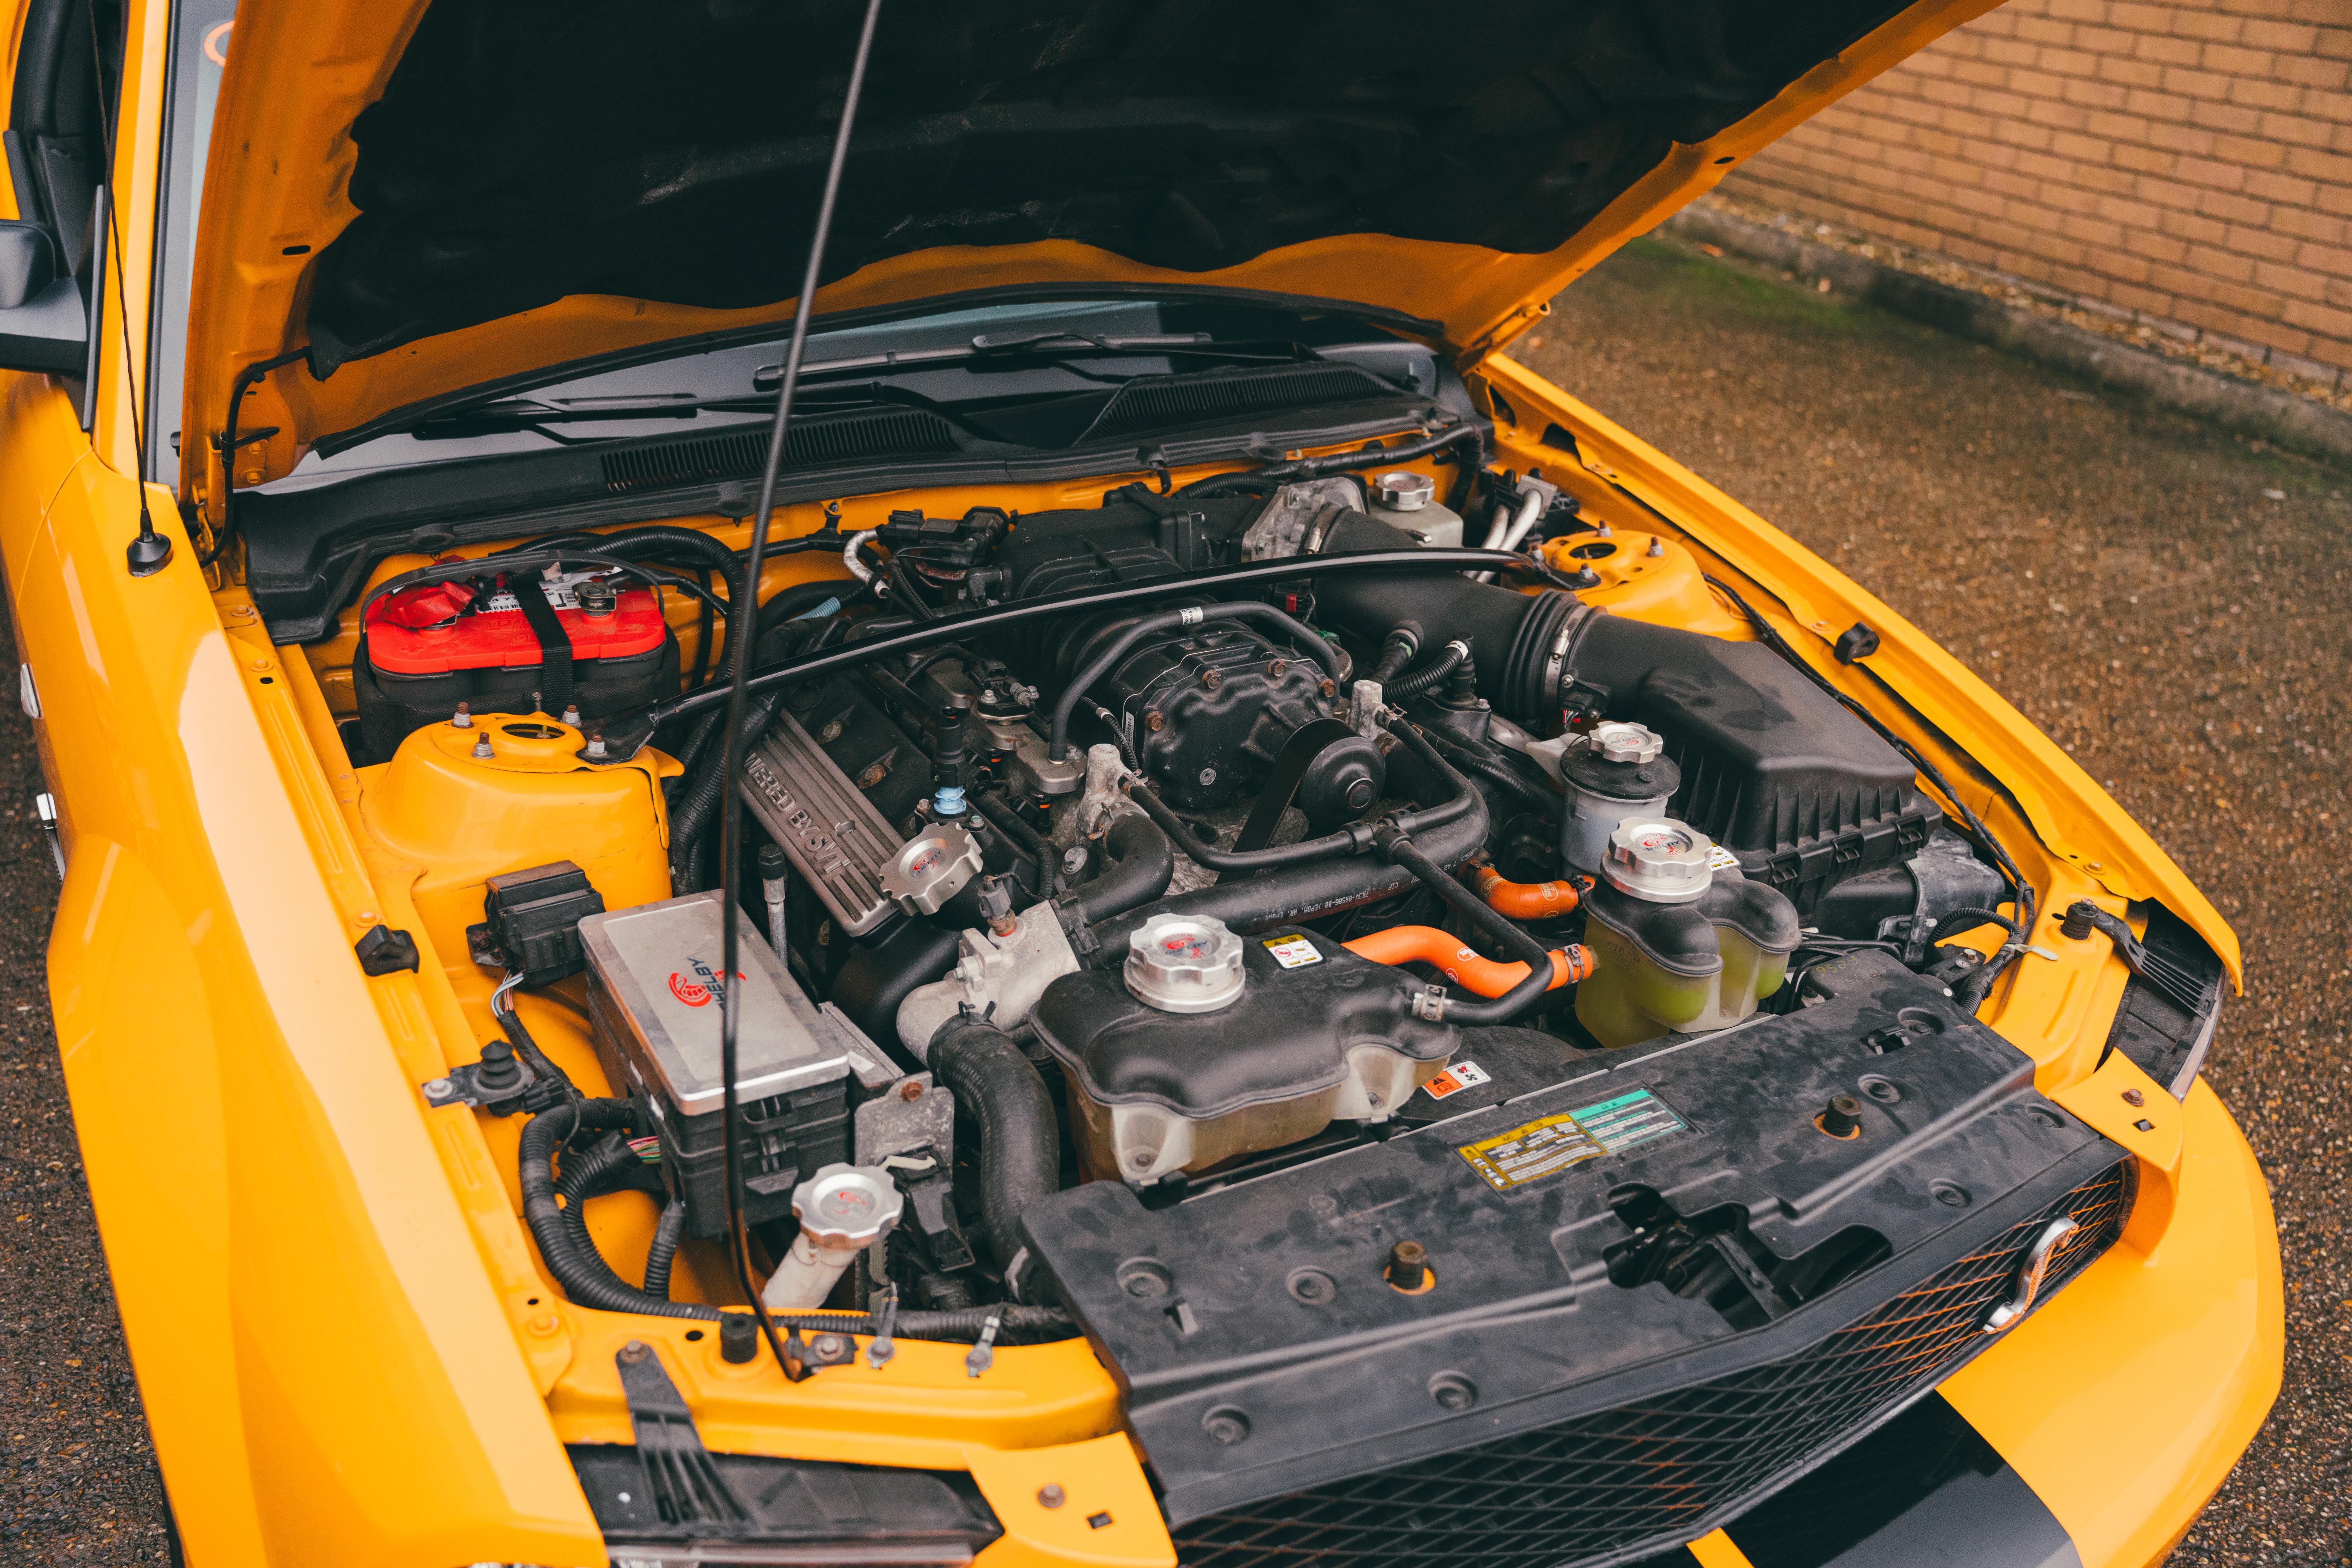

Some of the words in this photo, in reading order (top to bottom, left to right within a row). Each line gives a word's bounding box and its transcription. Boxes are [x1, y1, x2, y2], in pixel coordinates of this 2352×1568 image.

[744, 751, 796, 813] WERED
[786, 808, 820, 838] BY
[804, 833, 851, 874] SVT
[1637, 833, 1664, 844] CAUTION
[1644, 840, 1679, 851] SHELBY
[1165, 941, 1208, 955] SHELBY
